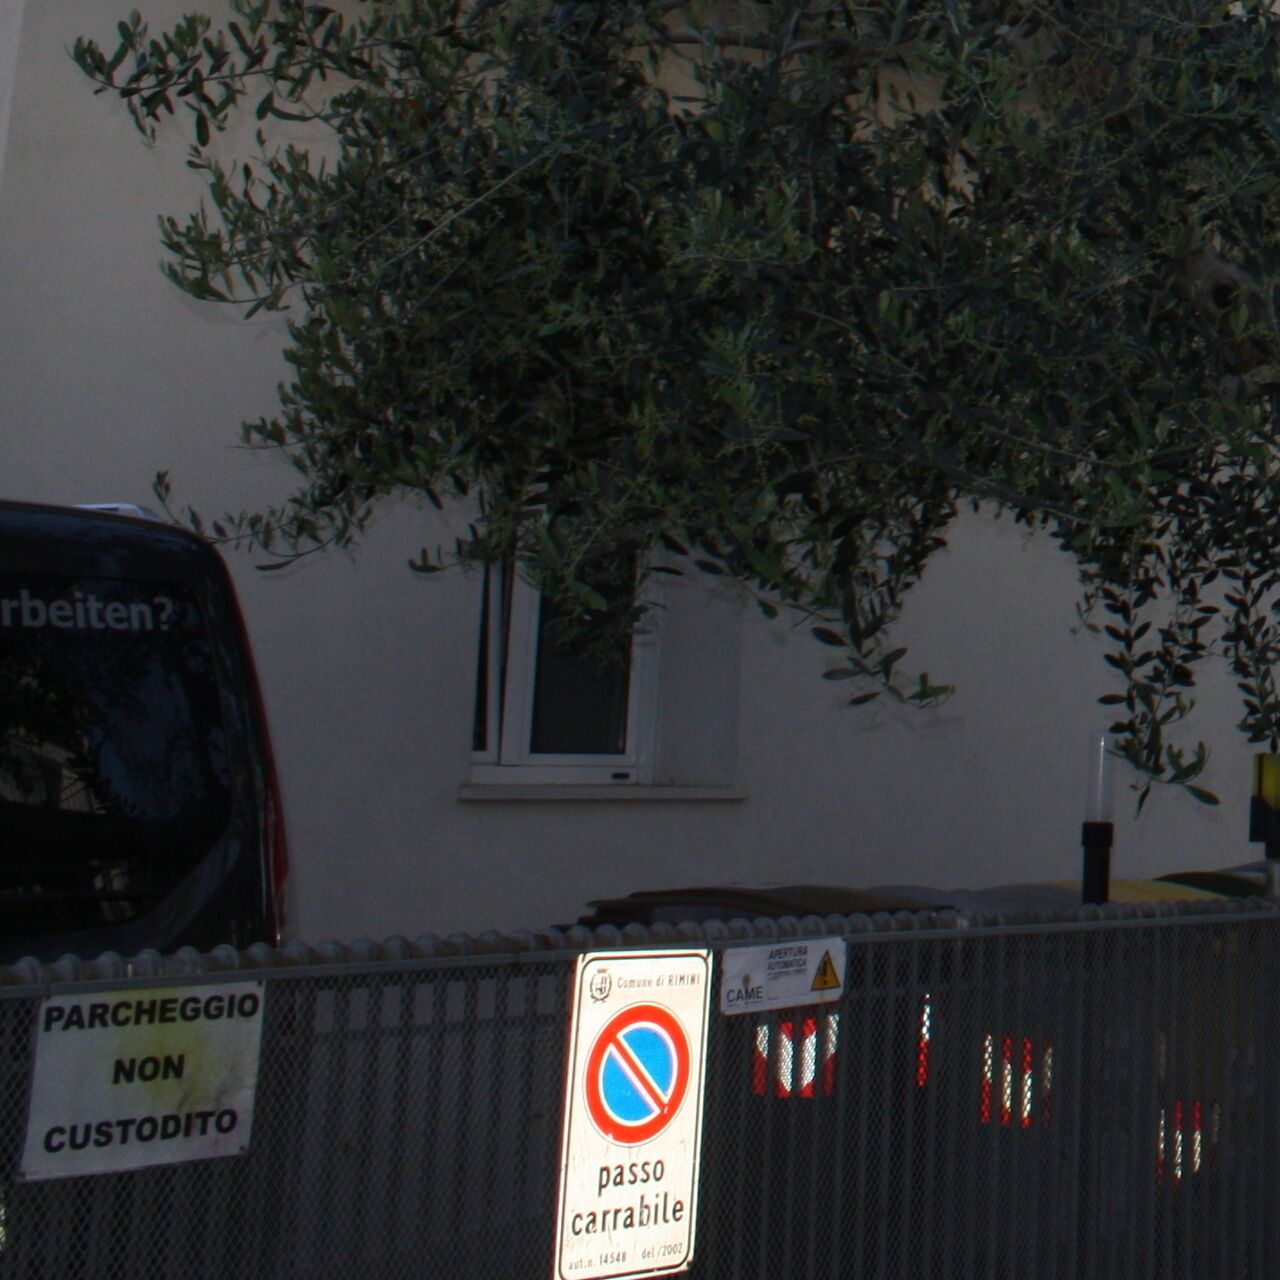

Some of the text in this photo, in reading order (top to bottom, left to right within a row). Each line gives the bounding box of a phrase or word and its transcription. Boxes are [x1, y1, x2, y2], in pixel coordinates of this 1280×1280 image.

[1, 588, 174, 631] rbeiten?
[617, 973, 700, 989] Comune di RIMINI
[726, 985, 764, 1003] CAME
[43, 993, 259, 1032] PARCHEGGIO
[112, 1054, 185, 1085] NON
[43, 1109, 238, 1153] CUSTODITO
[598, 1159, 665, 1197] passo
[571, 1191, 684, 1236] carrabile
